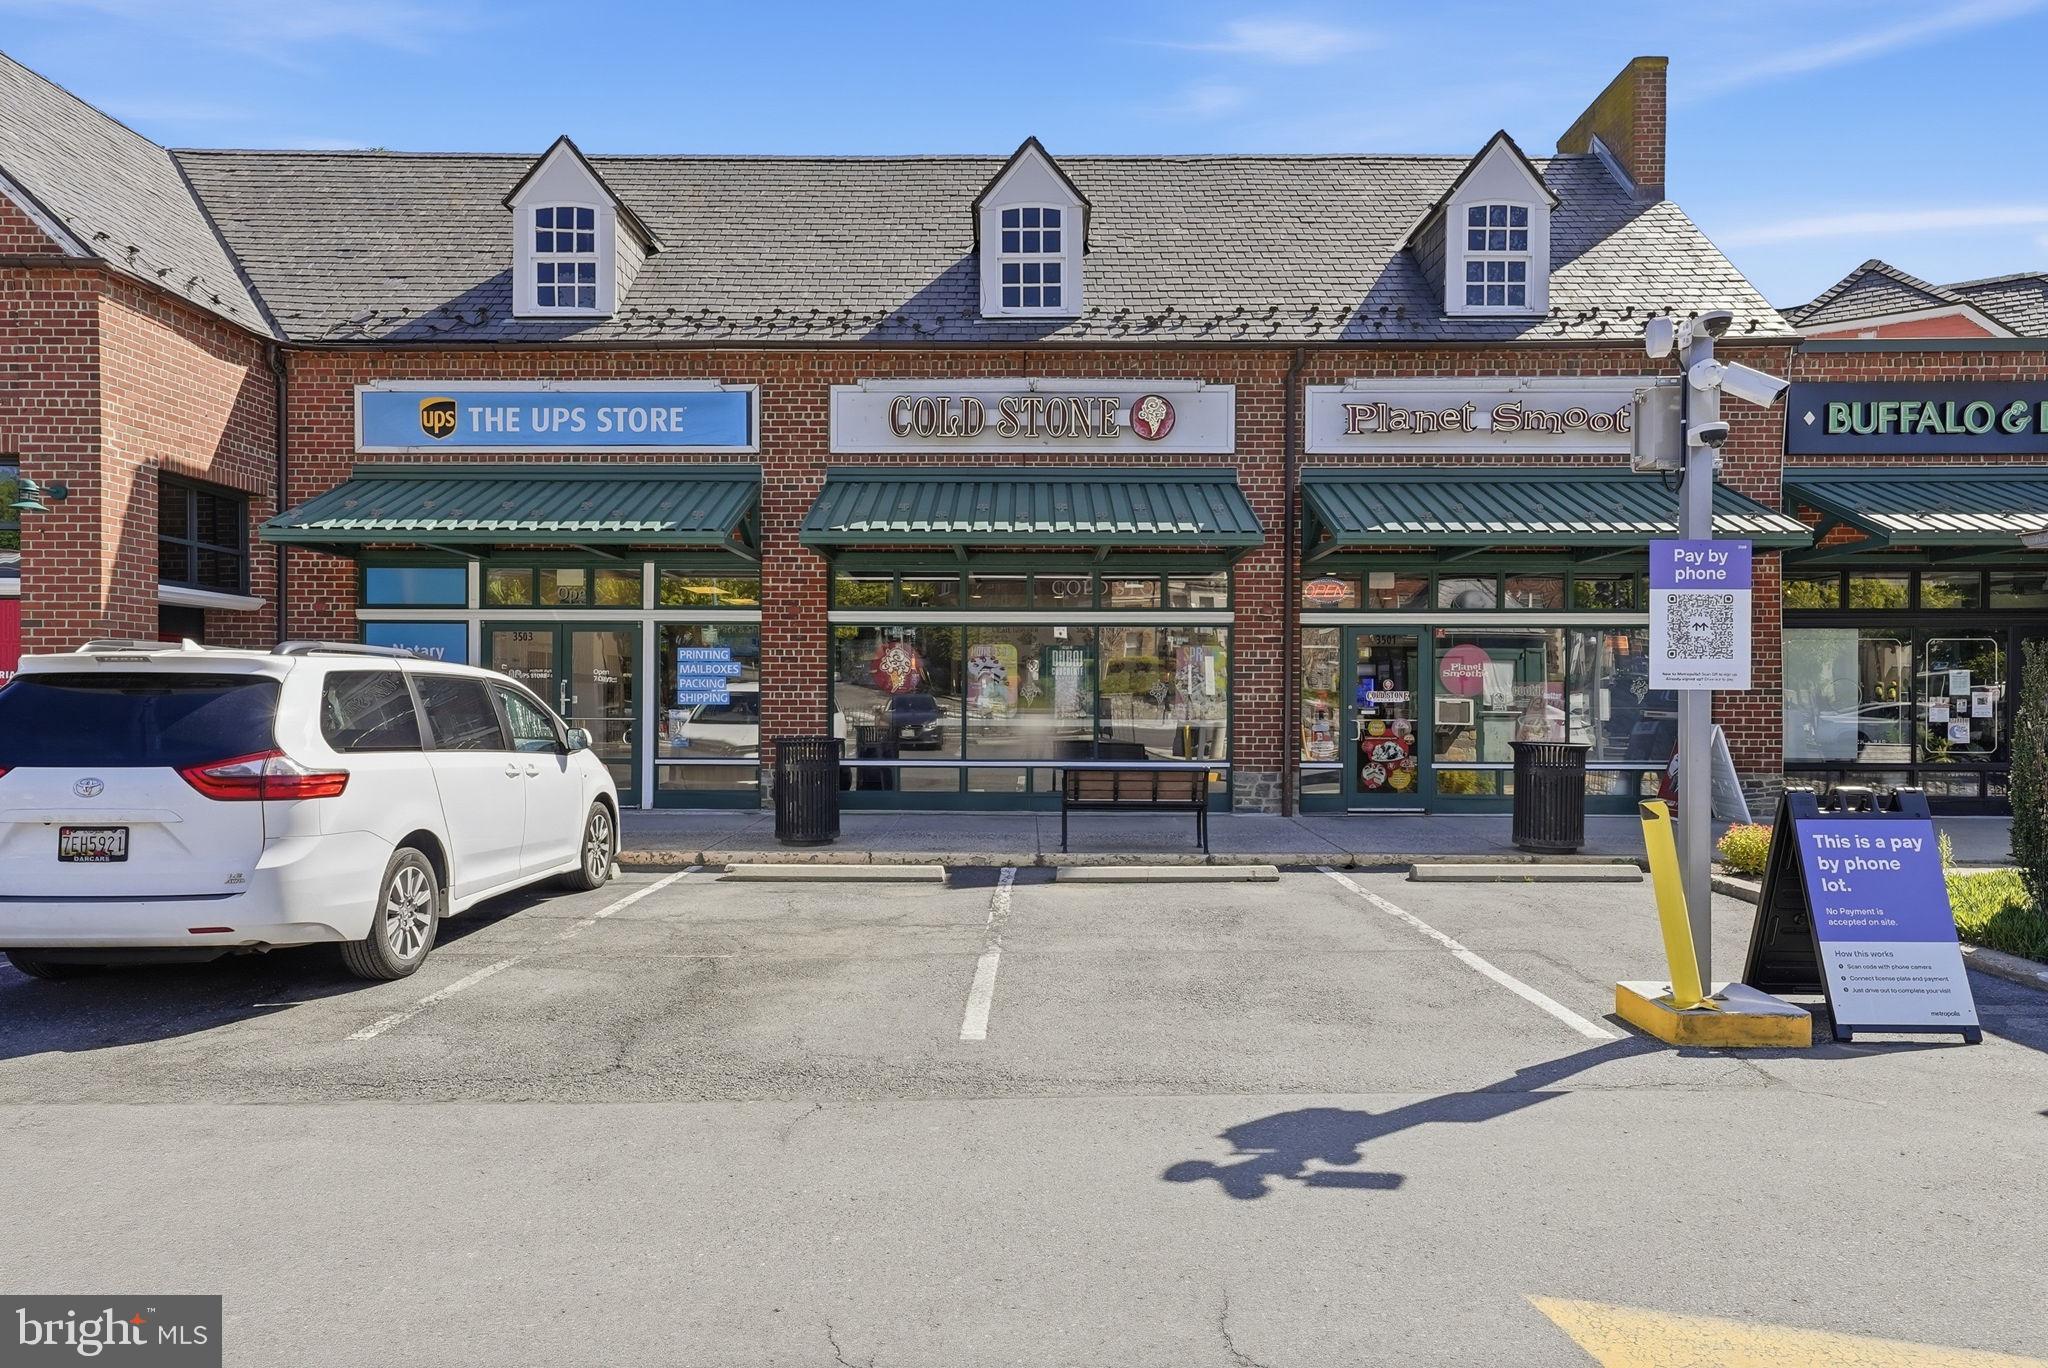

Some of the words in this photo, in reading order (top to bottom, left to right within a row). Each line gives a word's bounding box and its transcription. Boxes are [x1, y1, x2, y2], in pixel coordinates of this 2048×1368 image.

[422, 410, 456, 435] ups
[468, 407, 521, 433] THE
[531, 407, 587, 433] UPS
[597, 406, 685, 433] STORE
[888, 396, 987, 438] COLD
[996, 396, 1122, 438] STONE
[1343, 400, 1477, 435] Planet
[1490, 400, 1632, 435] Smoot
[1827, 399, 1997, 434] BUFFALO
[1674, 549, 1704, 566] Pay
[1708, 549, 1729, 566] by
[1675, 567, 1727, 583] phone
[1305, 584, 1348, 598] OPEN
[512, 632, 534, 642] 3503
[1376, 635, 1397, 645] 3501
[392, 643, 445, 660] tary
[679, 650, 729, 660] PRINTING
[679, 664, 739, 674] MAILBOXES
[679, 678, 725, 688] PACKING
[679, 693, 728, 703] SHIPPING
[62, 836, 122, 854] 7EH5921
[1813, 834, 1851, 849] This
[1855, 834, 1871, 849] is
[1875, 839, 1886, 849] a
[1891, 837, 1922, 852] pay
[1818, 856, 1839, 874] by
[1844, 857, 1901, 873] phone
[1821, 877, 1852, 892] lot.
[1826, 908, 1838, 916] No
[1840, 908, 1876, 917] Payment
[1876, 908, 1884, 916] is
[1828, 918, 1867, 927] accepted
[1881, 918, 1898, 926] site.
[1835, 950, 1852, 958] How
[1854, 950, 1869, 958] this
[1870, 950, 1894, 958] works
[1930, 1010, 1961, 1018] metropolis
